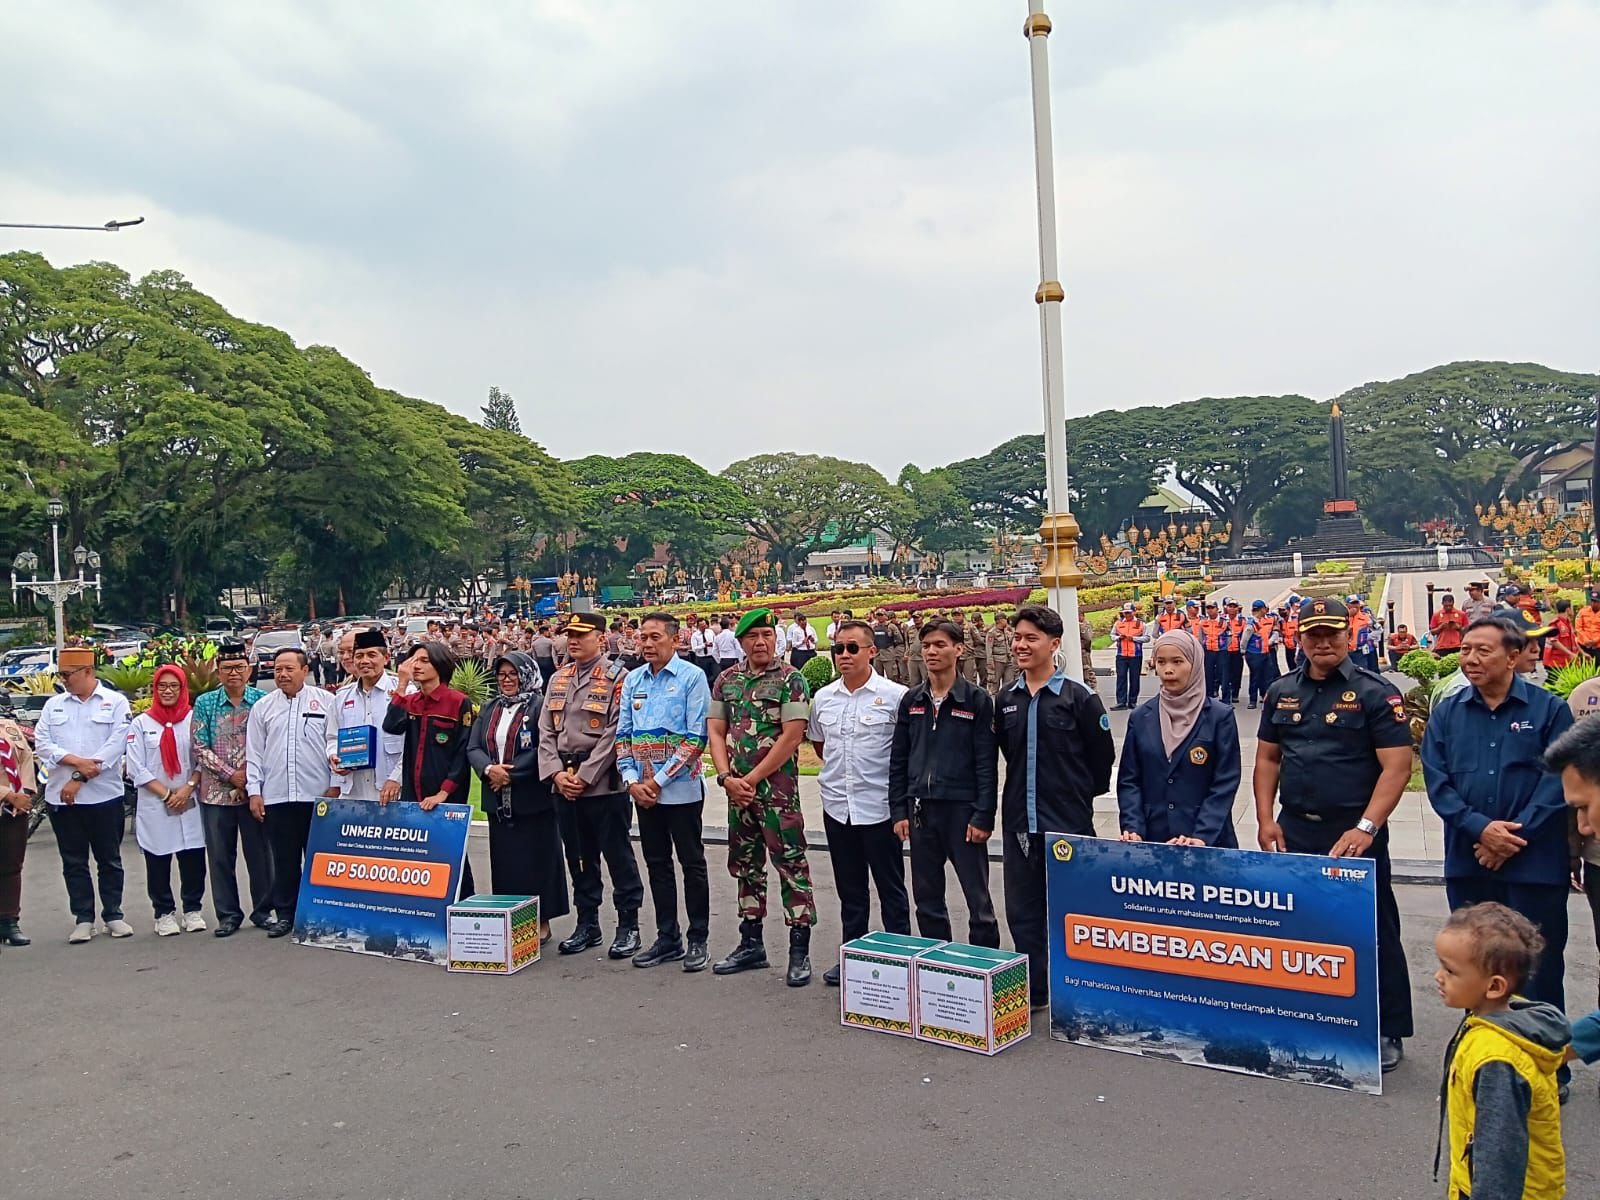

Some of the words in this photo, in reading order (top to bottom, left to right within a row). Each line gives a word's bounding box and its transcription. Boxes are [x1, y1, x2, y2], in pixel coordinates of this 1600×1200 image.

[341, 824, 382, 838] UNMER
[384, 828, 428, 842] PEDULI
[326, 861, 346, 877] RP
[349, 863, 431, 886] 50.000.000
[1322, 866, 1368, 878] unmer
[1111, 876, 1196, 902] UNMER
[1202, 886, 1294, 912] PEDULI
[1123, 903, 1156, 914] Solidaritas
[1156, 906, 1176, 915] untuk
[1177, 909, 1214, 920] mahasiswa
[1214, 912, 1252, 924] terdampak
[1254, 916, 1280, 927] berupa:
[1073, 924, 1272, 970] PEMBEBASAN
[1282, 951, 1345, 978] UKT
[1064, 976, 1080, 988] Bagi
[1081, 978, 1120, 992] mahasiswa
[1122, 984, 1162, 998] Universitas
[1164, 990, 1198, 1004] Merdeka
[1199, 994, 1229, 1010] Malang
[1230, 1000, 1276, 1016] terdampak
[1278, 1006, 1314, 1021] bencana
[1316, 1011, 1359, 1026] Sumatera
